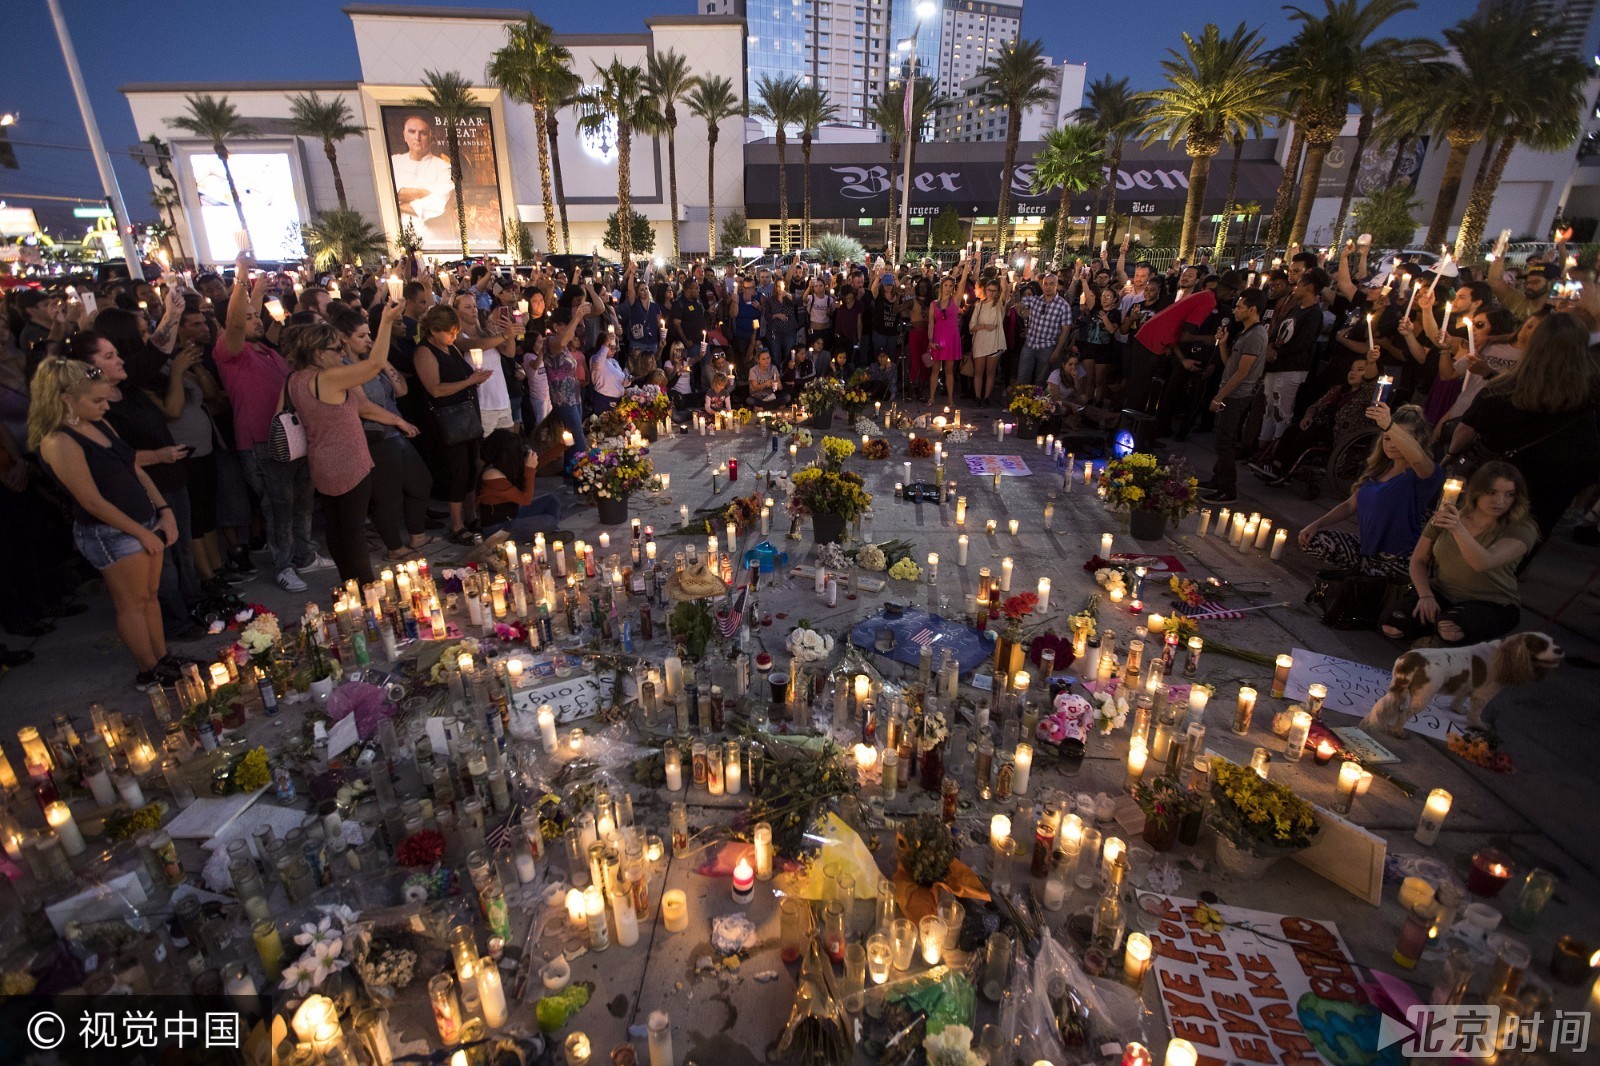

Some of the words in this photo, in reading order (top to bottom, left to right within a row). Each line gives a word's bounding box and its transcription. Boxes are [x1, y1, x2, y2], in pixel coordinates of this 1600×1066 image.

[1017, 203, 1047, 214] Beers
[1131, 201, 1155, 213] Bets
[1150, 898, 1198, 965] FOR
[1159, 968, 1221, 1048] EYE
[1211, 990, 1278, 1065] EYE
[1236, 951, 1325, 1066] MAKE
